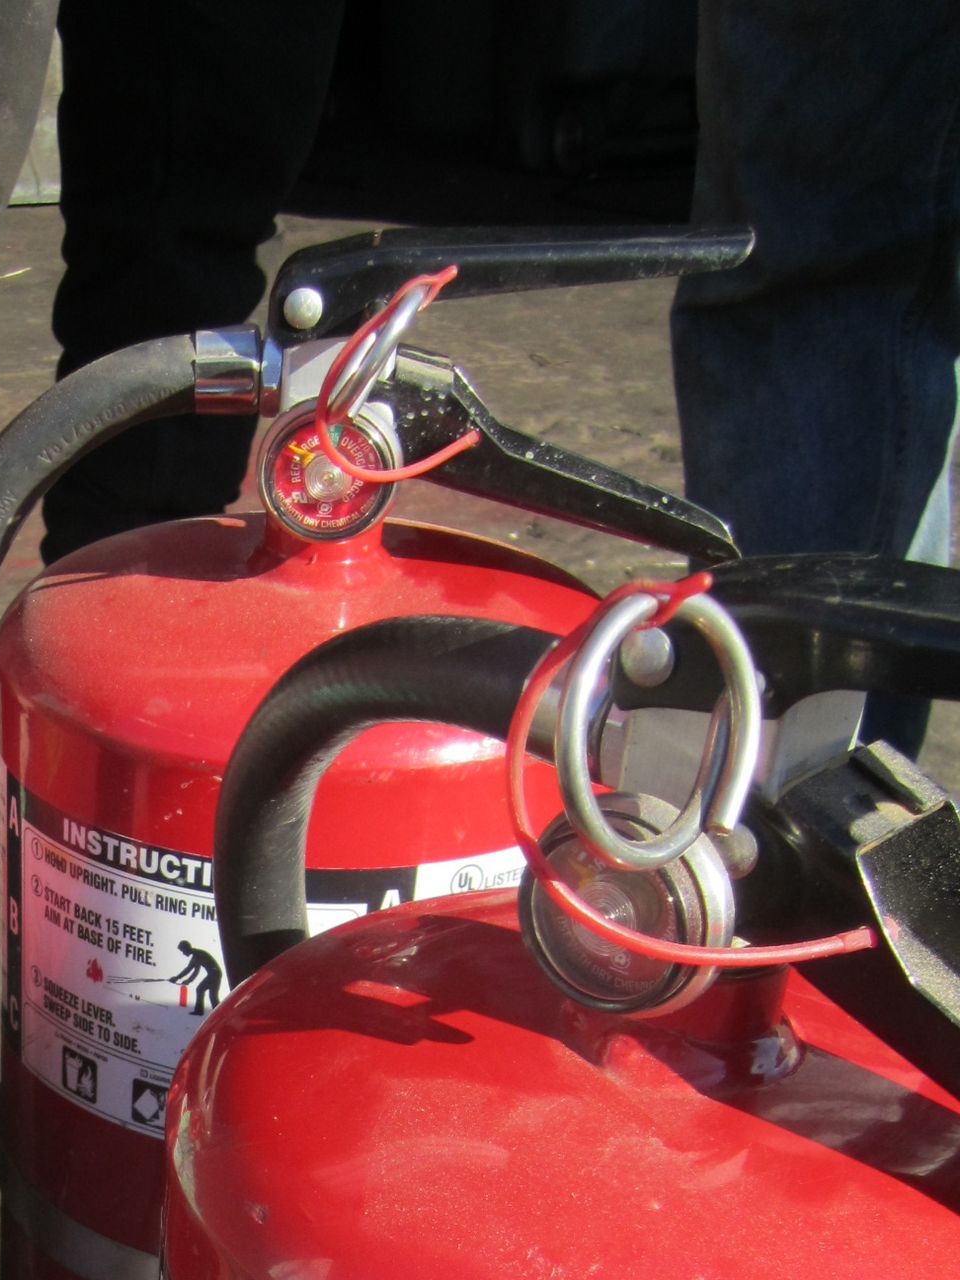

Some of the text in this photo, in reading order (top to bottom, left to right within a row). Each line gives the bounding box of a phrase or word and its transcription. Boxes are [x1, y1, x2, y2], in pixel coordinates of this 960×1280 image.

[9, 795, 20, 838] A
[44, 847, 187, 916] HOLD UPRIGHT. PULL RING
[63, 818, 213, 887] INSTRUCTI
[457, 867, 523, 891] UL LISTE
[9, 897, 20, 935] B
[44, 886, 155, 947] START BACK 15 FEET.
[44, 905, 157, 967] AIM AT BASE OF FIRE.
[43, 994, 72, 1023] SWEEP
[73, 1013, 94, 1036] SIDE
[97, 1025, 111, 1043] TO
[113, 1032, 142, 1055] SIDE.
[44, 976, 117, 1028] SQUEEZE LEVER.
